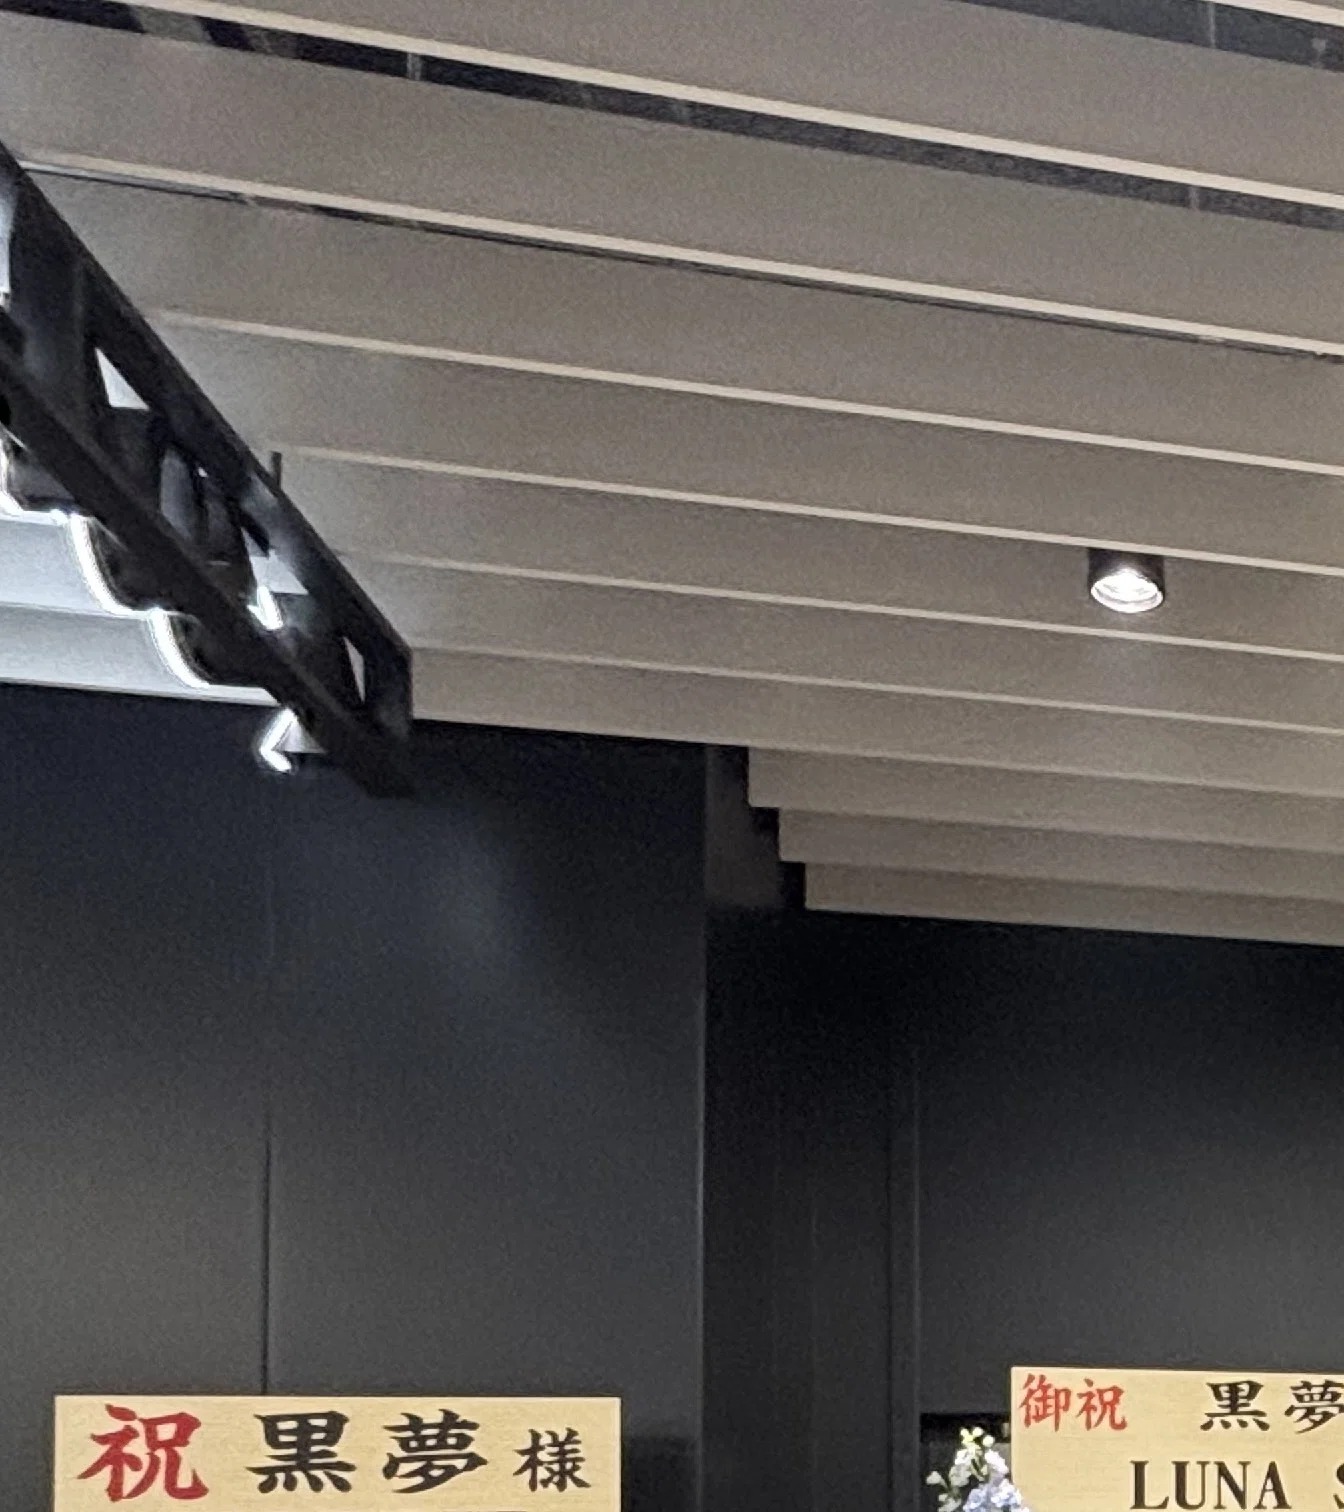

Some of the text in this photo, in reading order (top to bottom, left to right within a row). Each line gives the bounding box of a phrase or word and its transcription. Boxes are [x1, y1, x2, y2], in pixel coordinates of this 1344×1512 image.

[1019, 1373, 1128, 1432] 御祝
[77, 1404, 209, 1502] 祝
[1130, 1460, 1291, 1510] LUNA
